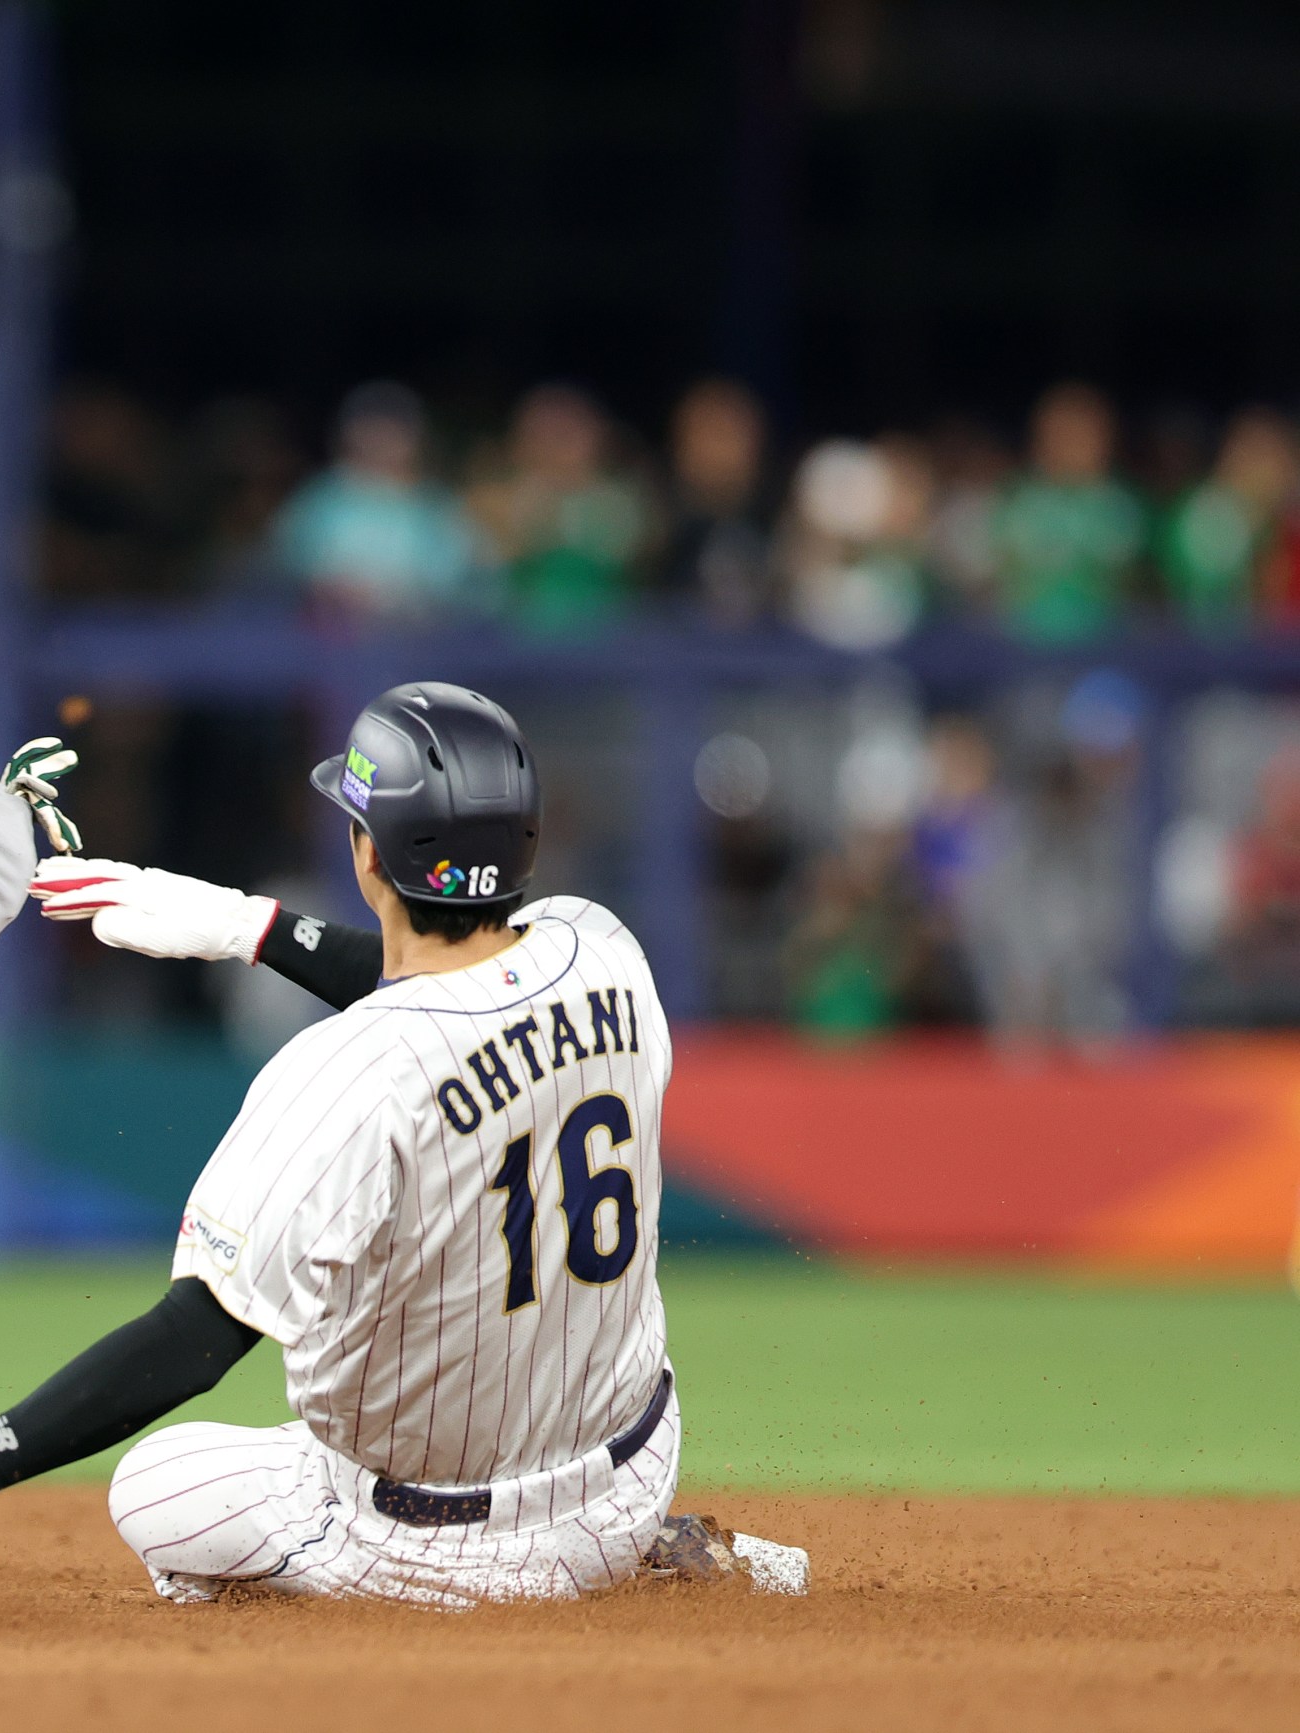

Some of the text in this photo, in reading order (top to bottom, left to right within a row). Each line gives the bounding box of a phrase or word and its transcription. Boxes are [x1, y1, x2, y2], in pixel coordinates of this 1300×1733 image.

[467, 865, 499, 897] 16
[437, 987, 639, 1136] OHTANI
[196, 1220, 237, 1260] MUFG
[487, 1089, 640, 1316] 16
